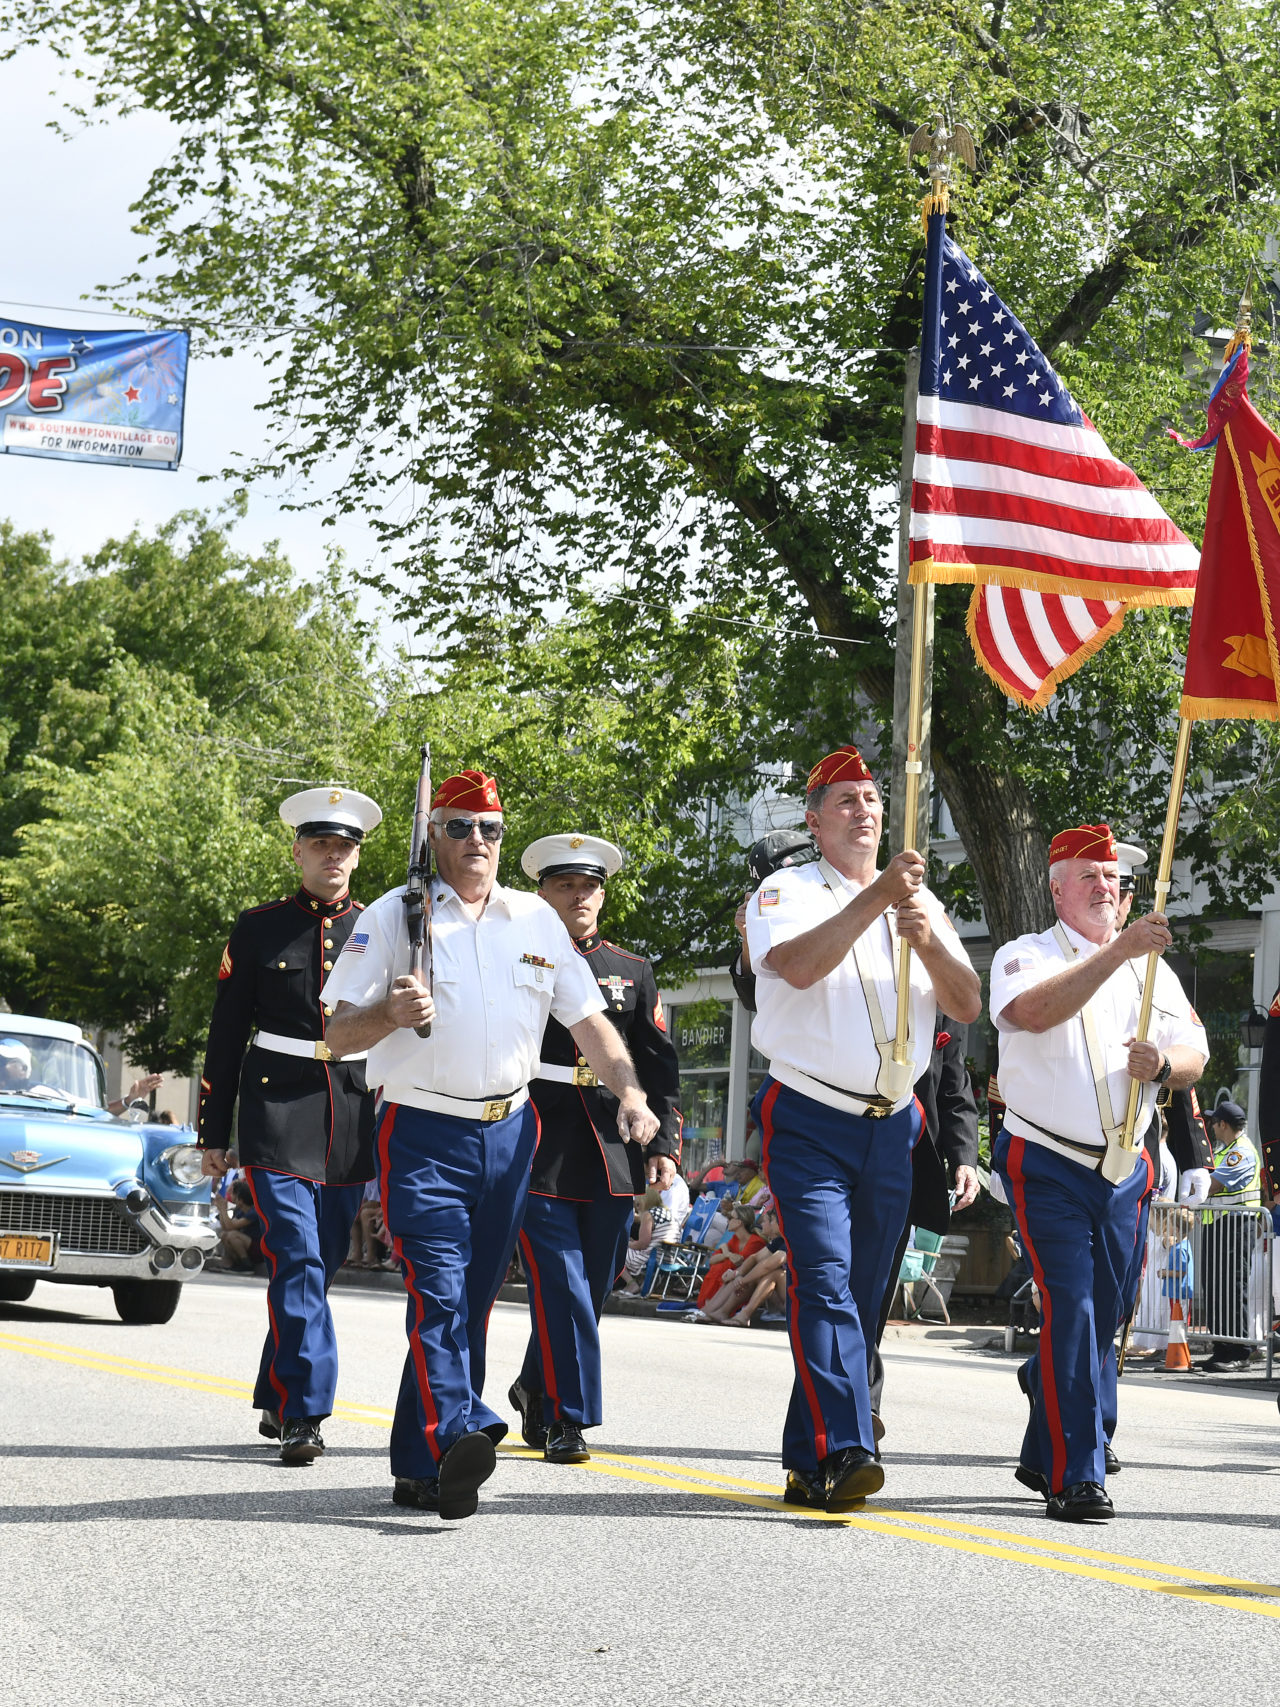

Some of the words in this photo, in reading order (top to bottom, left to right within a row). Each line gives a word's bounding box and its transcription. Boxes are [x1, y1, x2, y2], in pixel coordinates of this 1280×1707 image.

[41, 436, 62, 448] FOR
[66, 439, 144, 456] INFORMATION
[682, 1026, 725, 1047] BANDIER
[16, 1241, 43, 1259] RITZ
